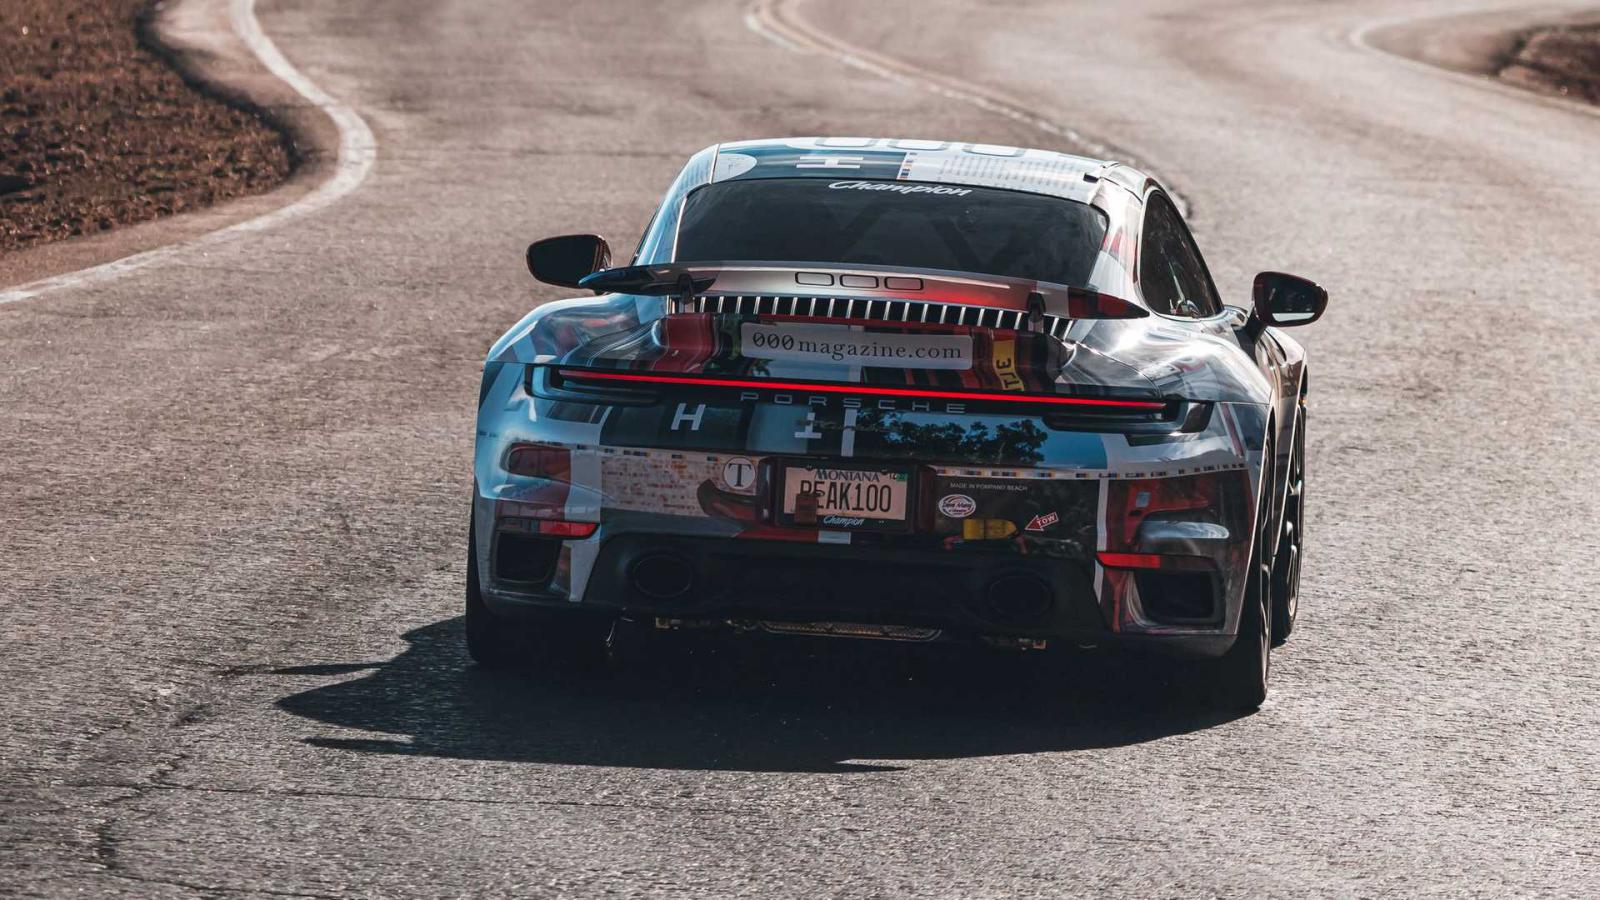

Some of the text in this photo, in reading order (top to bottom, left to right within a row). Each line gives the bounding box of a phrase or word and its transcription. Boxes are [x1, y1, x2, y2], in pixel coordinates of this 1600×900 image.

[828, 180, 974, 197] Champion
[752, 332, 962, 361] 000magazine.com
[740, 392, 966, 413] PORSCHE
[671, 403, 706, 430] H
[728, 463, 752, 487] T
[814, 469, 880, 482] MONTANA
[822, 515, 866, 527] Champion
[1036, 515, 1056, 527] TOW
